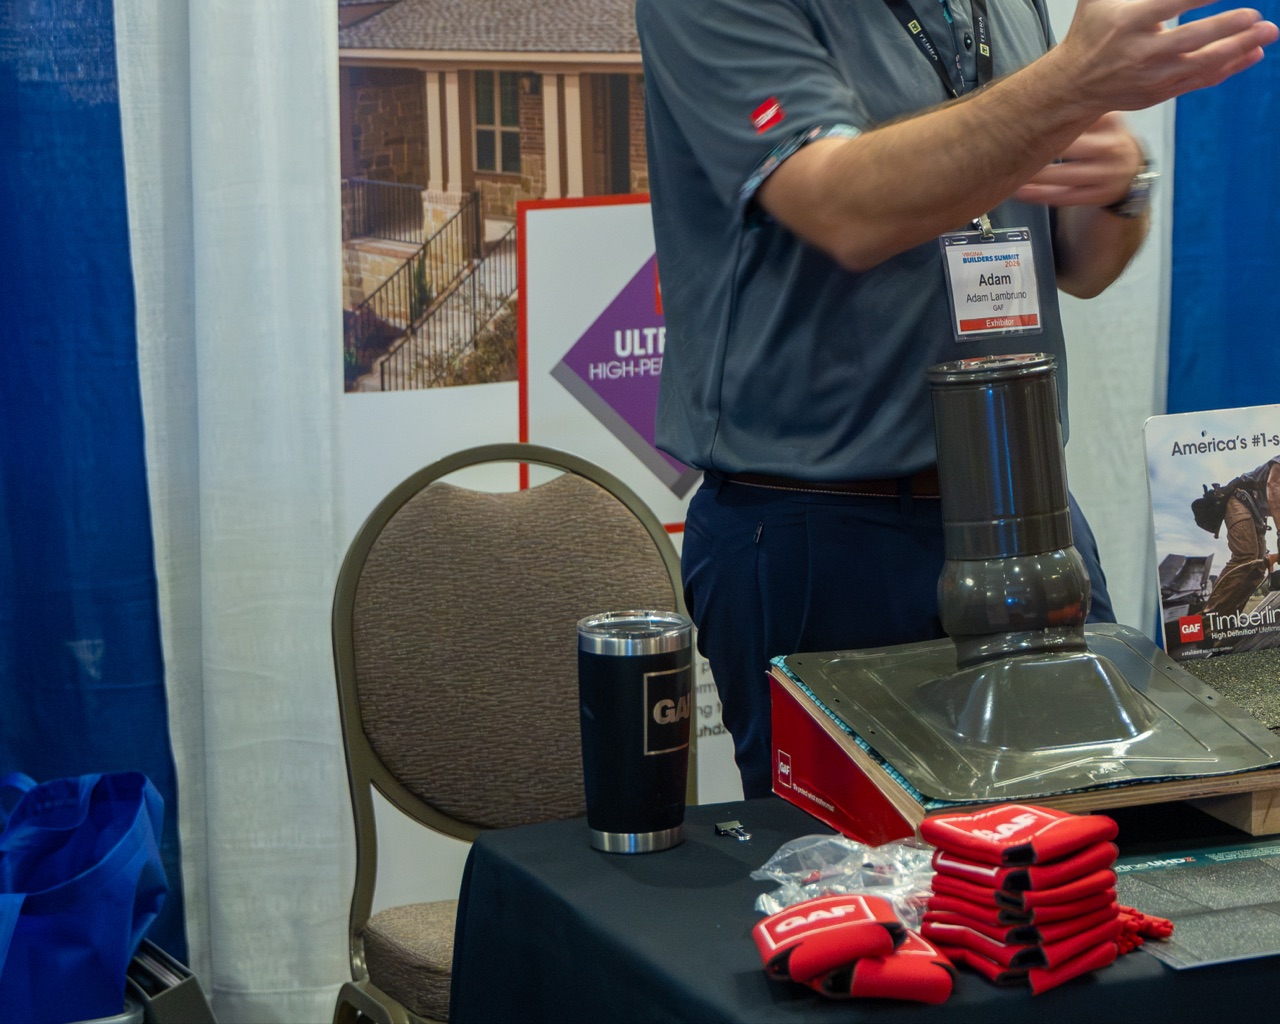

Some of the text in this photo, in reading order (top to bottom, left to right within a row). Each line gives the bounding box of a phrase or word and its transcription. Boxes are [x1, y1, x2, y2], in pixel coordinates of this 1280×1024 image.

[962, 253, 1020, 264] BUILDERS SUMMIT
[978, 273, 1012, 287] Adam
[966, 293, 989, 304] Adam
[992, 304, 1005, 312] GAF
[985, 318, 1015, 328] Exhibitor
[589, 356, 664, 380] HIGH-PE
[1181, 624, 1201, 635] GAF
[1211, 632, 1227, 641] High
[780, 761, 791, 775] GAF
[972, 813, 1038, 841] GAF
[775, 904, 856, 933] GAF
